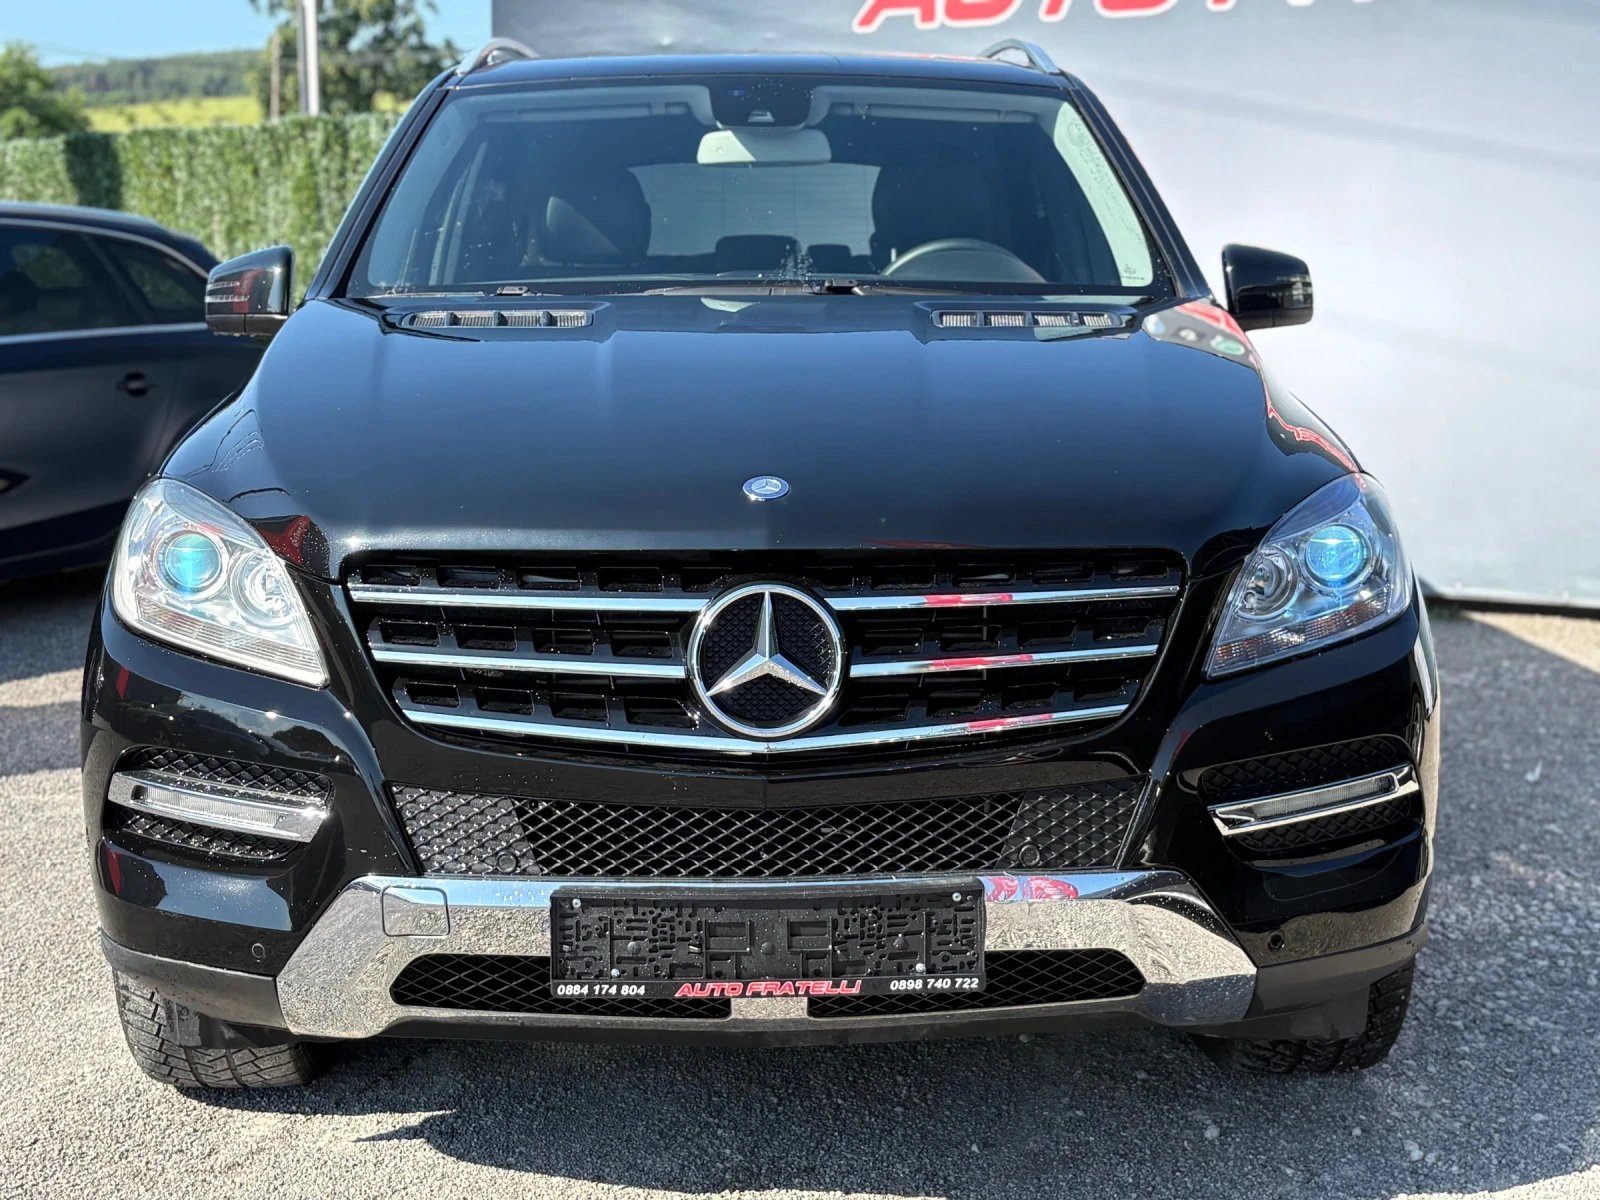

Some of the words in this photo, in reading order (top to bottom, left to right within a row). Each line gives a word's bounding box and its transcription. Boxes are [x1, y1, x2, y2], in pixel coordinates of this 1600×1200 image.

[557, 984, 589, 996] 0884
[593, 984, 617, 995] 174
[620, 984, 646, 995] 804
[674, 982, 743, 997] AUTO
[745, 979, 862, 996] FRATELLI
[889, 978, 923, 990] 0898
[926, 978, 951, 989] 740
[954, 977, 979, 989] 722
